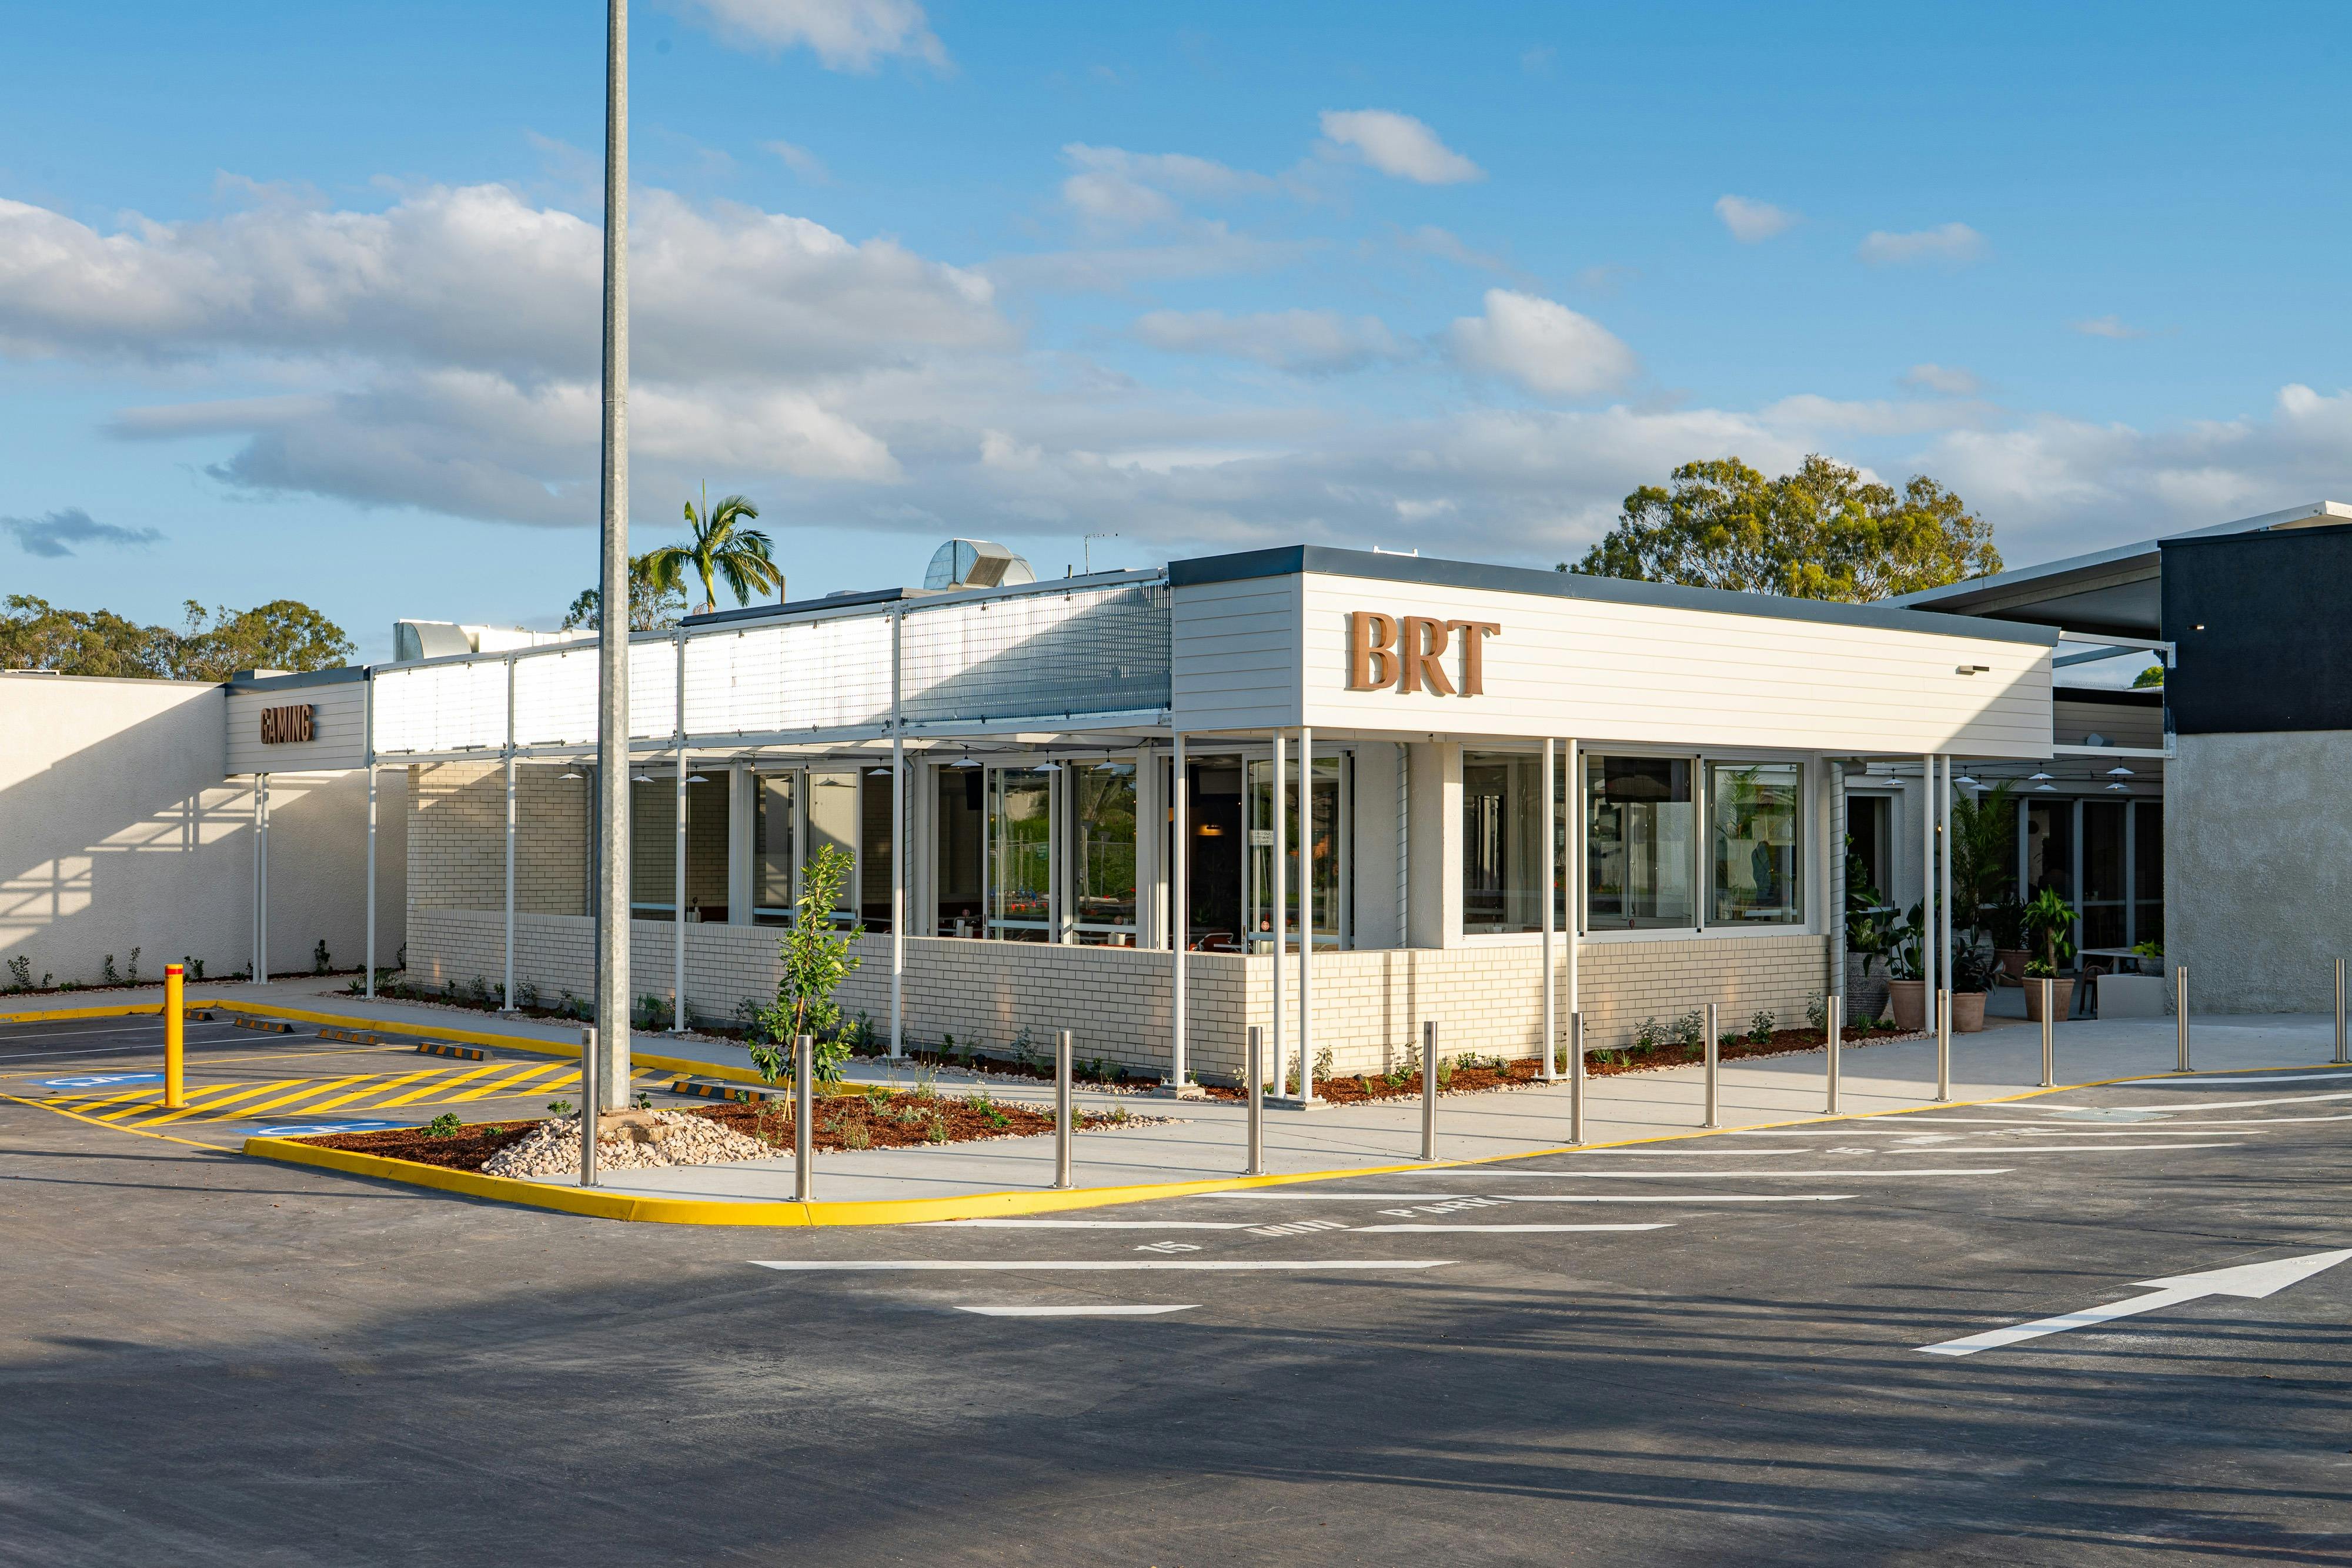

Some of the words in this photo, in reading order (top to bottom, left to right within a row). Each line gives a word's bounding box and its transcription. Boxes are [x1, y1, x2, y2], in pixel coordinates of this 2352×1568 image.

[1351, 611, 1501, 696] BRT
[260, 704, 314, 744] GAMING
[1825, 1146, 1876, 1155] 15
[1132, 1241, 1204, 1254] 15
[1242, 1219, 1351, 1237] MIN
[1375, 1196, 1515, 1218] PARK
